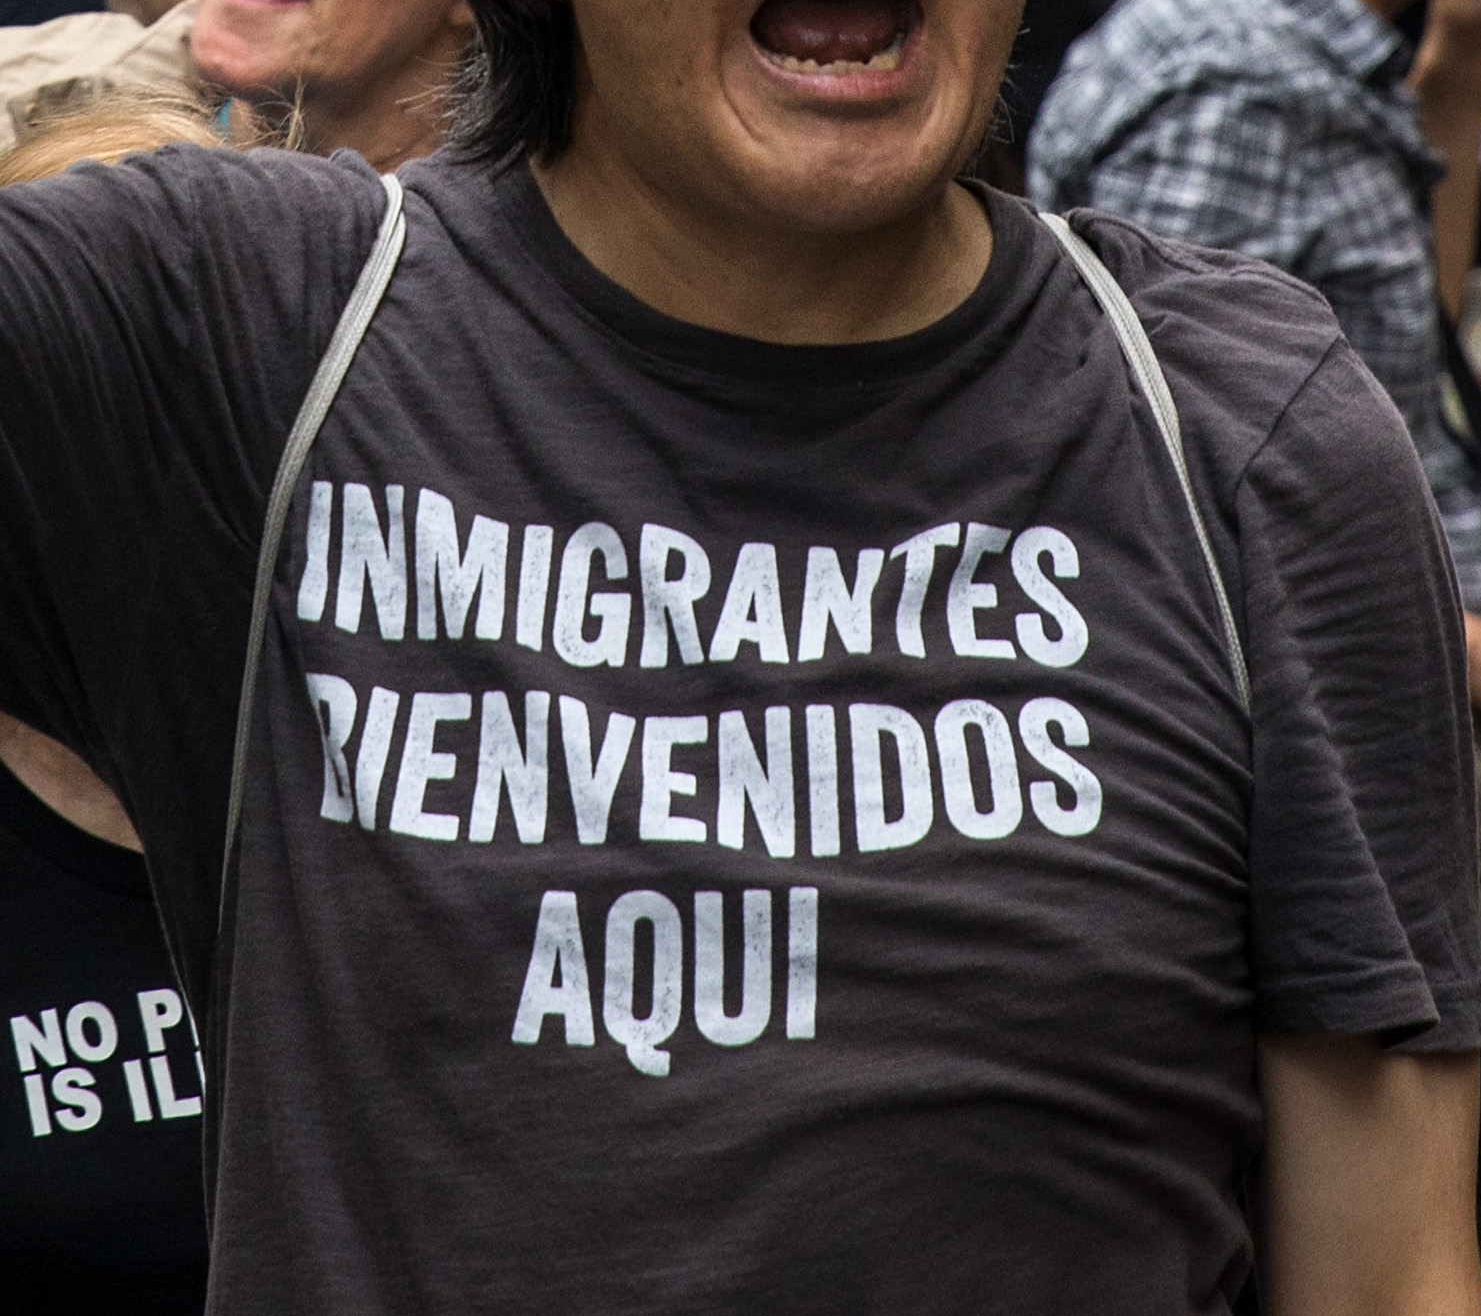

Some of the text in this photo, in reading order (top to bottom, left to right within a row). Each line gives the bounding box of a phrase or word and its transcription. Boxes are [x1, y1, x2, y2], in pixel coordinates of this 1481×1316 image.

[295, 480, 1089, 668] INMIGRANTES
[305, 671, 1102, 859] BIENVENIDOS
[9, 999, 119, 1073] NO
[510, 885, 820, 1078] AQUI
[22, 1050, 207, 1137] IS IL
